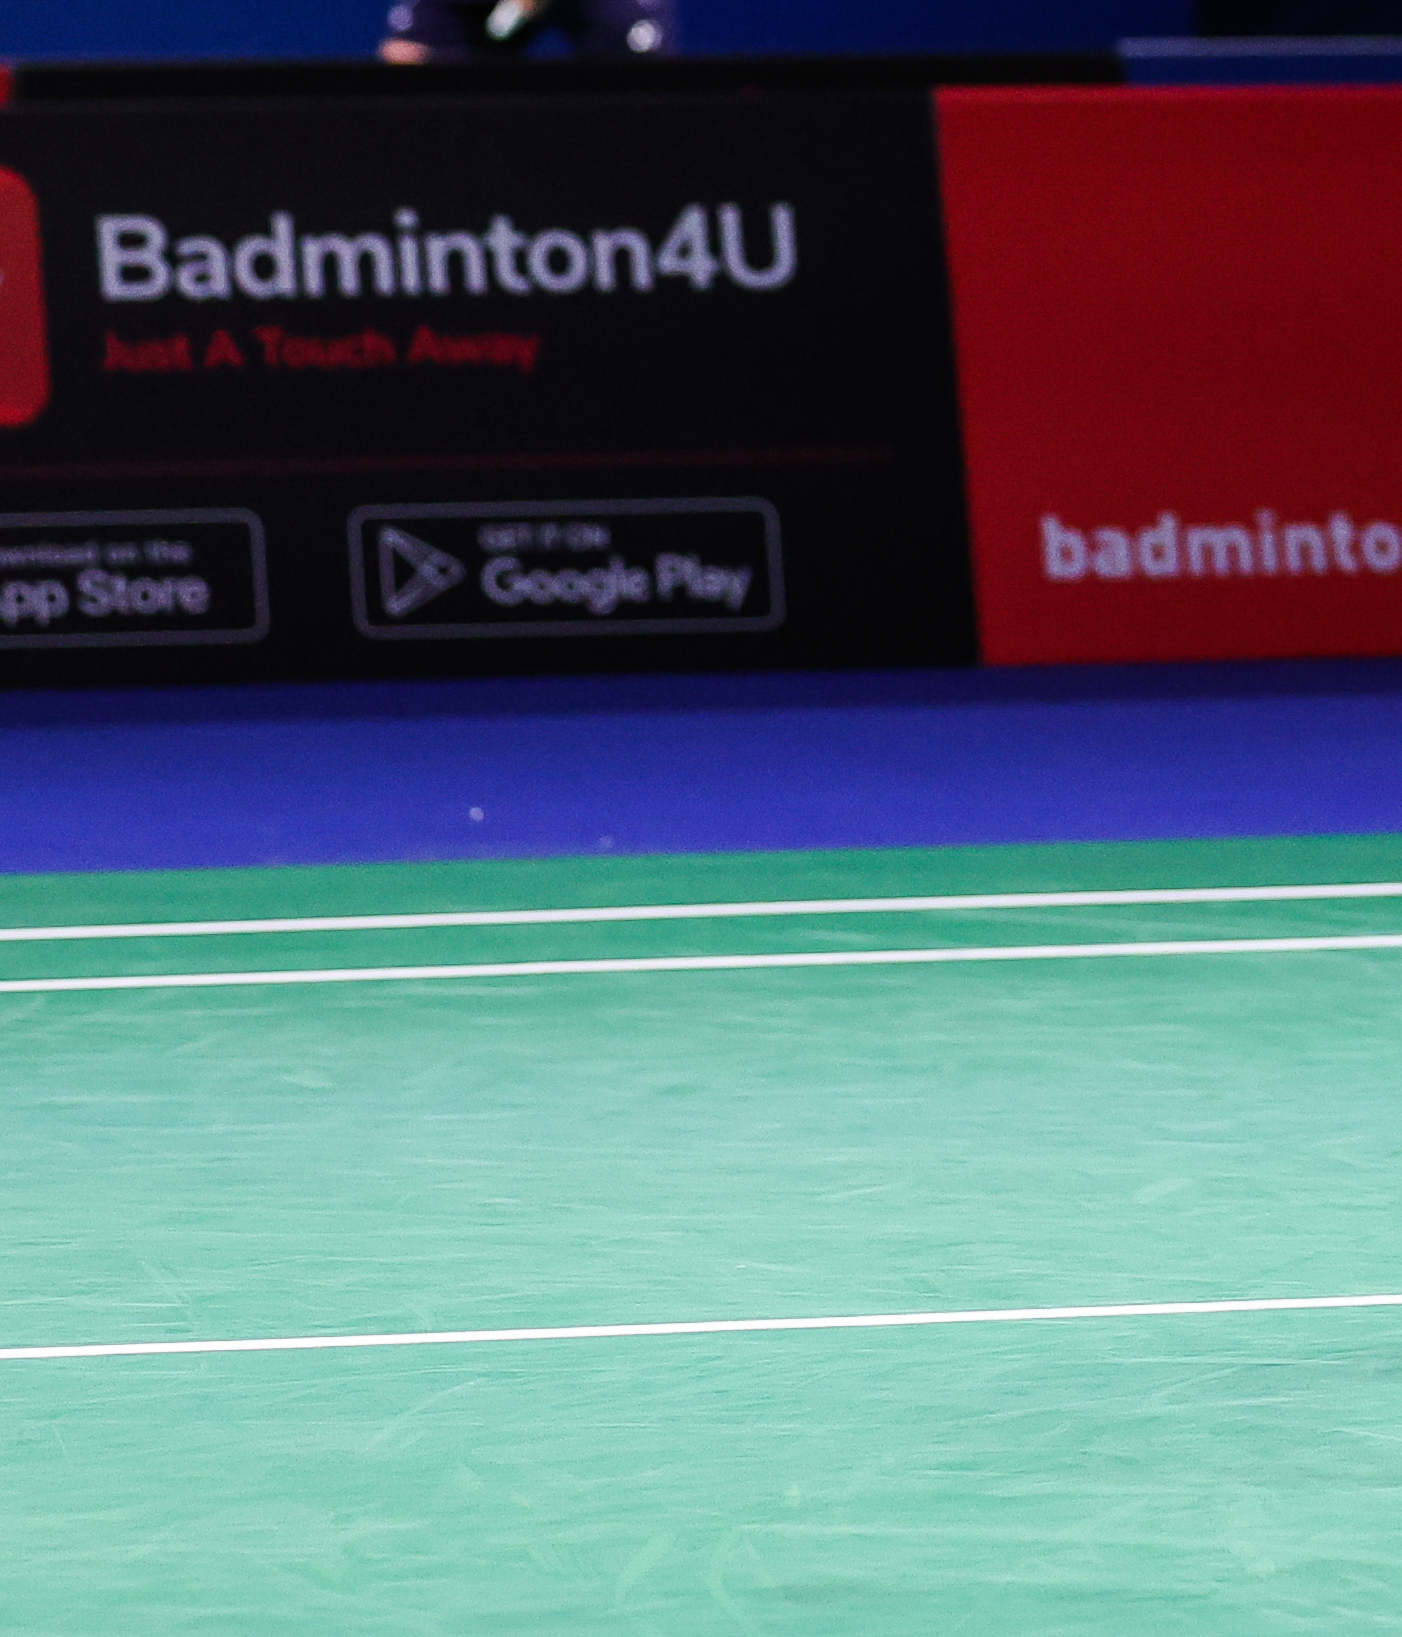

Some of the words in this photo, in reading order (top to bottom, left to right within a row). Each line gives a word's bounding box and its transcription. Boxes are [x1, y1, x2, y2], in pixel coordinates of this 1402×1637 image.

[95, 201, 798, 302] Badminton4U
[103, 328, 193, 372] Just
[204, 328, 246, 368] A
[253, 324, 396, 368] Touch
[407, 324, 541, 375] Away
[0, 577, 71, 627] pp
[76, 567, 211, 617] Store
[480, 555, 649, 615] Google
[655, 551, 752, 611] Play
